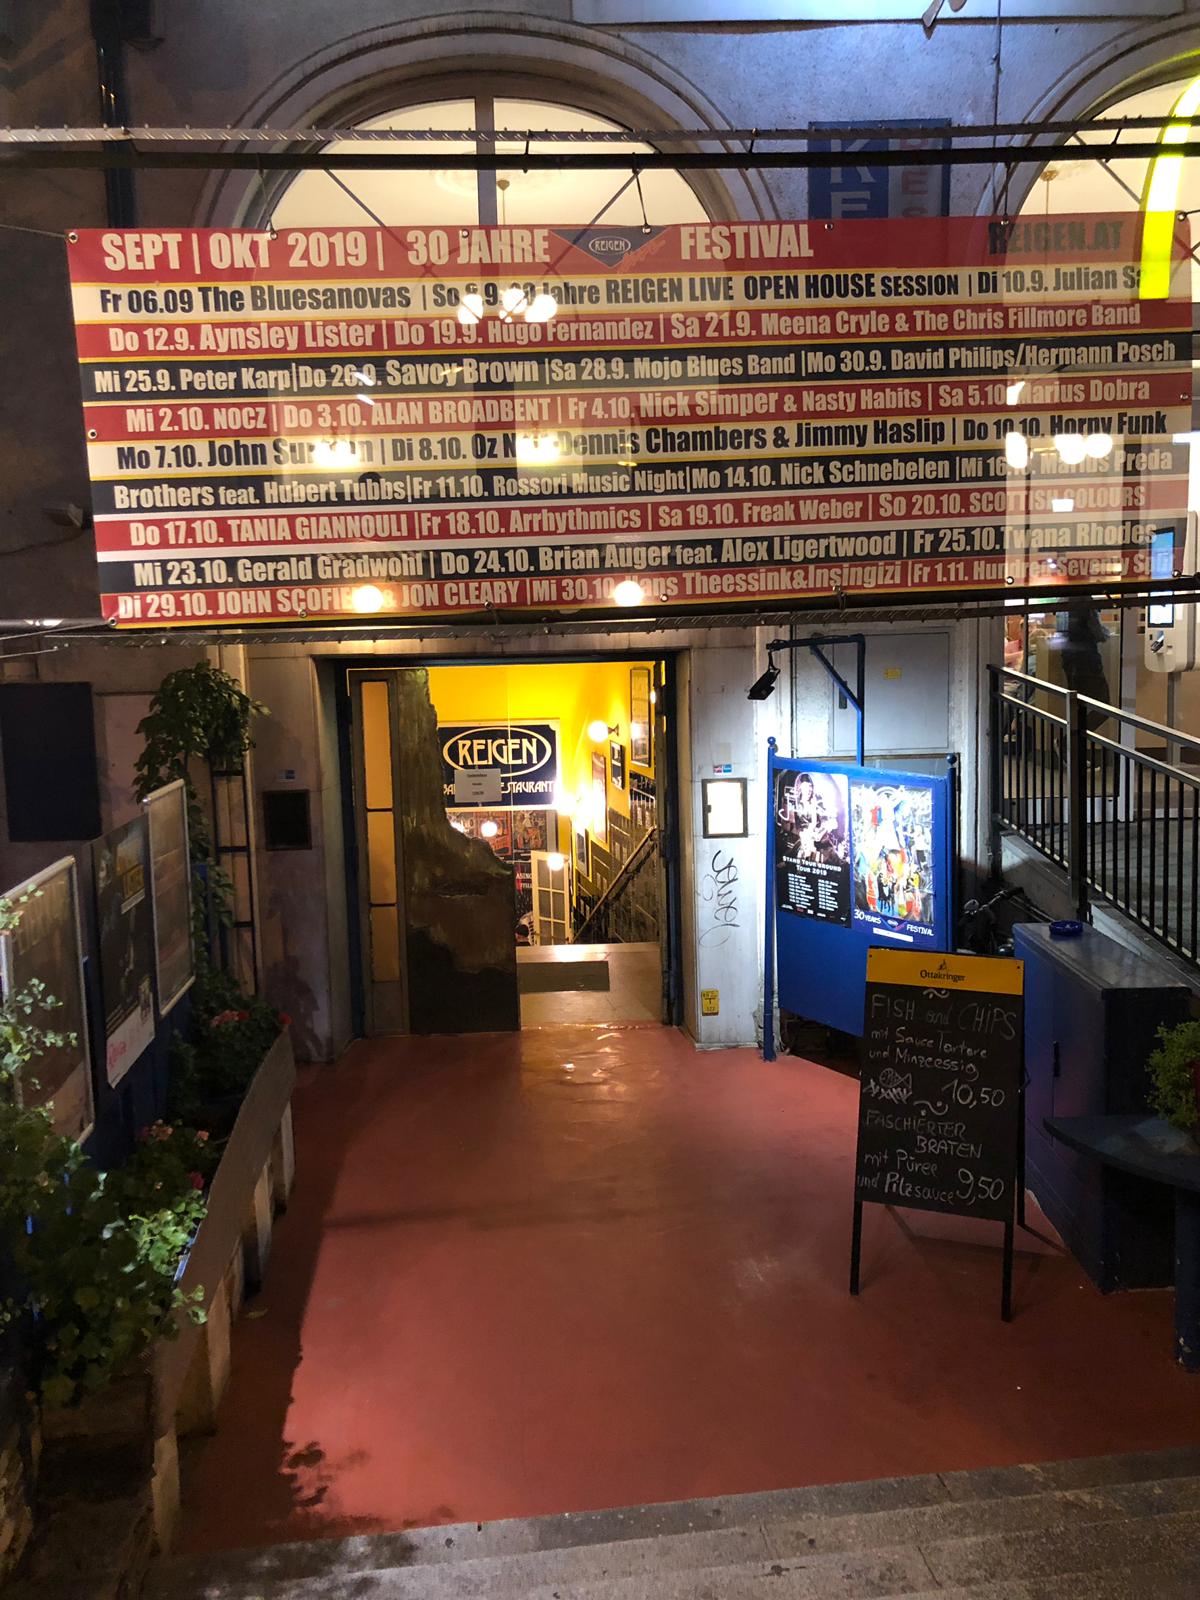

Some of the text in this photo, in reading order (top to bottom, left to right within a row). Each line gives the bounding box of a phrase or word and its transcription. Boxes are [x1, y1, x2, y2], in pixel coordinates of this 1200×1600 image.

[101, 232, 182, 271] SEPT
[208, 231, 270, 269] OKT
[288, 231, 367, 268] 2019
[406, 230, 448, 264] 30
[457, 229, 550, 264] JAHRE
[594, 240, 626, 250] REIGEN
[680, 224, 813, 260] FESTIVAL
[989, 221, 1123, 255] REIGEN.AT
[100, 289, 121, 313] Fr
[128, 289, 194, 314] 06.09
[198, 287, 245, 312] The
[251, 286, 411, 311] Bluesanovas
[432, 283, 460, 307] So
[606, 278, 683, 304] REIGEN
[689, 277, 734, 301] LIVE
[744, 275, 799, 300] OPEN
[805, 274, 875, 298] HOUSE
[881, 274, 959, 297] SESSION
[978, 272, 997, 294] Di
[1003, 271, 1048, 293] 10.9.
[1053, 267, 1117, 291] Julian
[109, 304, 1140, 352] Do 12.9. Aynsley Lister Do 19.9. Hugo Fernandez Sa 21.9. Meena Cryle The Chris Fillmore Band
[94, 340, 1175, 393] Mi 25.9. Peter 26.9. Savoy Brown 28.9. Mojo Blues Band 30.9. David Philips/Hermann Posch
[126, 379, 1150, 432] Mi 2.10. NOCZ Do 3.10. ALAN BROADBENT Fr 4.10. Nick Simper & Nasty Habits Sa Dobra
[118, 447, 150, 469] Mo
[155, 446, 202, 468] 7.10.
[208, 440, 267, 466] John
[392, 438, 414, 462] Di
[419, 436, 467, 460] 8.10.
[472, 436, 498, 458] Oz
[557, 429, 640, 455] Dennis
[646, 426, 766, 453] Chambers
[773, 427, 789, 448] &
[794, 423, 867, 448] Jimmy
[874, 418, 944, 444] Haslip
[964, 420, 988, 440] Do
[1118, 411, 1166, 434] Funk
[114, 484, 214, 508] Brothers
[218, 486, 259, 506] feat.
[264, 480, 338, 504] Hubert
[436, 475, 488, 498] 11.10.
[493, 474, 568, 496] Rossori
[572, 472, 630, 493] Music
[724, 465, 776, 487] 14.10.
[780, 462, 824, 484] Nick
[829, 458, 950, 484] Schnebelen
[1114, 450, 1172, 472] Preda
[130, 494, 964, 546] Do 17.10. TANIA GIANNOULI 18.10. Arrhythmics Sa 19.10. Freak Weber So 20.10.
[134, 520, 1156, 586] Mi 23.10. Gerald Gradwohl Do 24.10. Brian Auger feat. Alex Ligertwood Fr 25.10. Twana Rhodes
[118, 562, 968, 618] Di 29.10. JOHN JON CLEARY Theessink&Insingizi 1.11.
[458, 738, 538, 765] REIGEN
[854, 909, 865, 919] 30
[907, 924, 934, 936] FESTIVAL
[919, 969, 966, 982] Ottakringer
[871, 994, 915, 1021] FISH
[926, 1002, 953, 1025] and
[869, 1046, 890, 1058] und
[871, 1027, 888, 1040] mit
[895, 1026, 934, 1048] Sauce
[941, 1079, 1005, 1109] 10,50
[866, 1109, 966, 1140] FASCHIERTER
[865, 1152, 888, 1166] mit
[915, 1136, 982, 1159] BRATEN
[857, 1172, 954, 1205] und Pilzsauce
[956, 1168, 1004, 1205] 9,50
